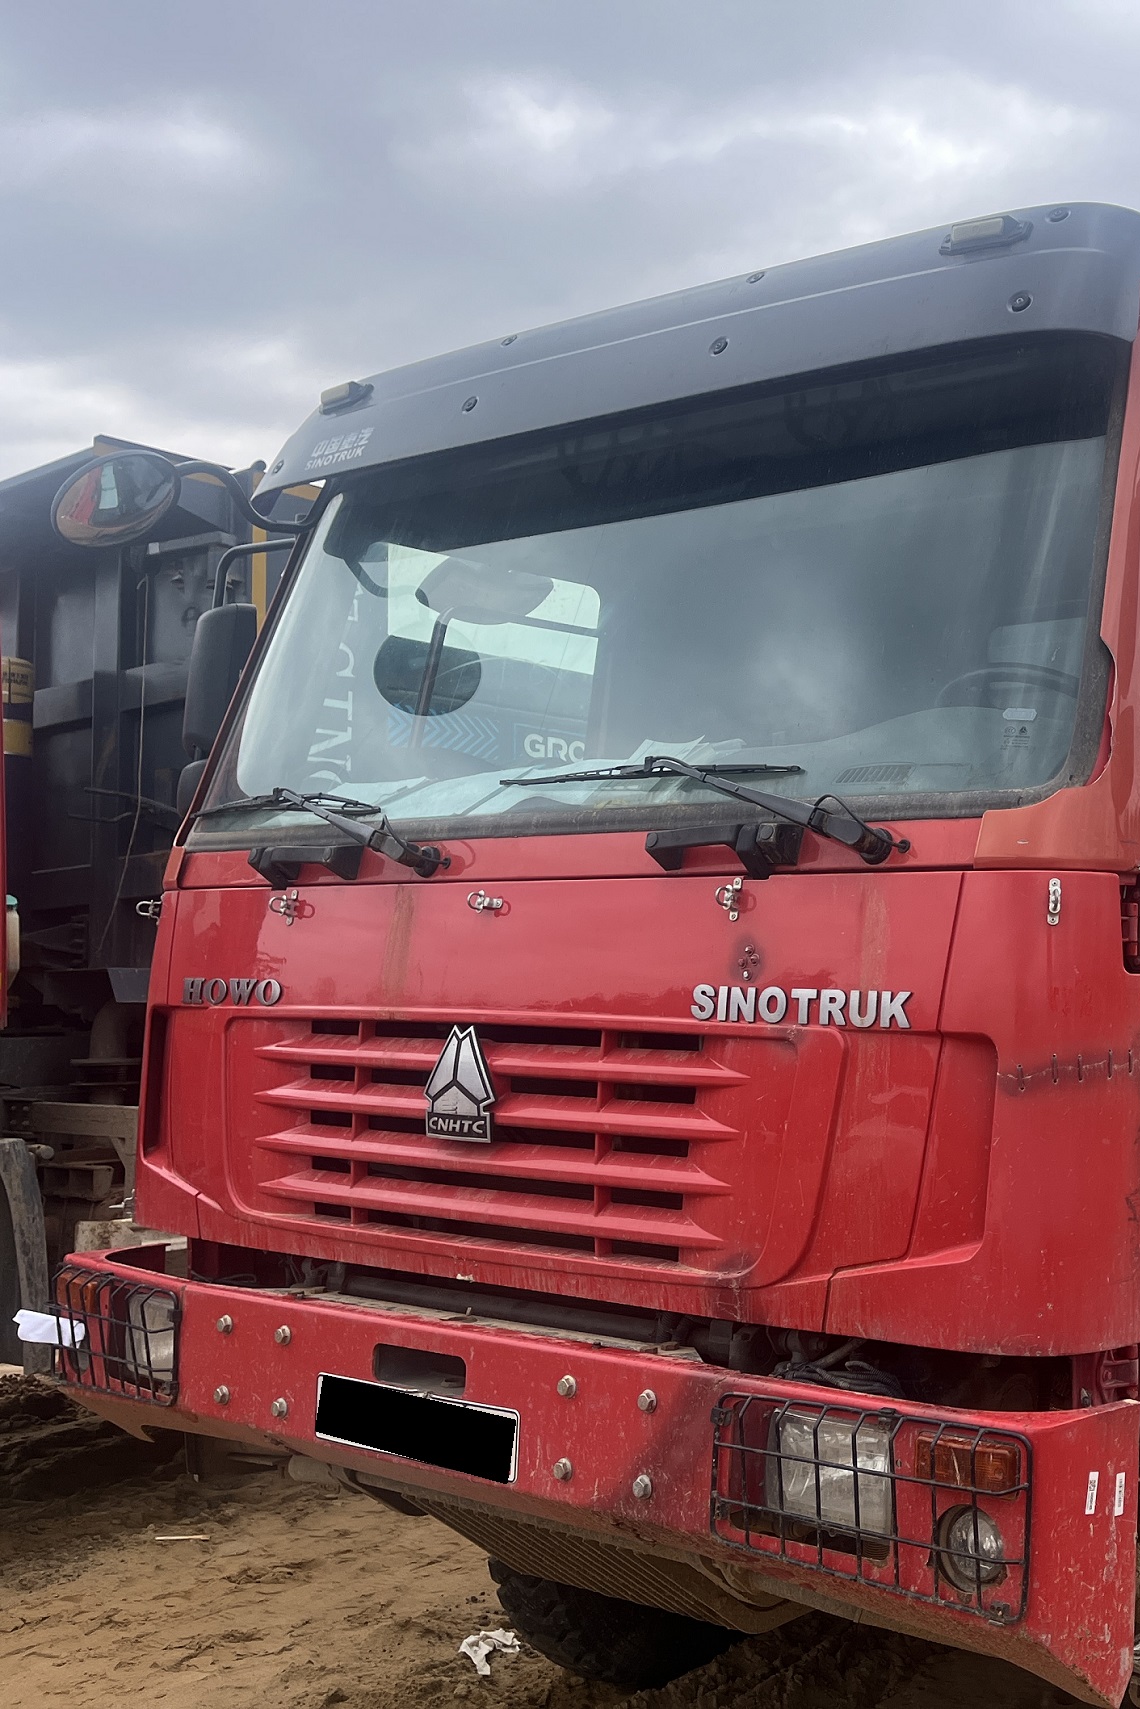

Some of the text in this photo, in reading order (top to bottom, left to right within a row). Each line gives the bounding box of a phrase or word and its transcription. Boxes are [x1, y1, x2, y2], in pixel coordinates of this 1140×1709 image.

[304, 446, 366, 471] SINOTRUK
[182, 977, 282, 1006] HOWO
[690, 983, 912, 1029] SINOTRUK
[428, 1116, 485, 1135] CNHTC
